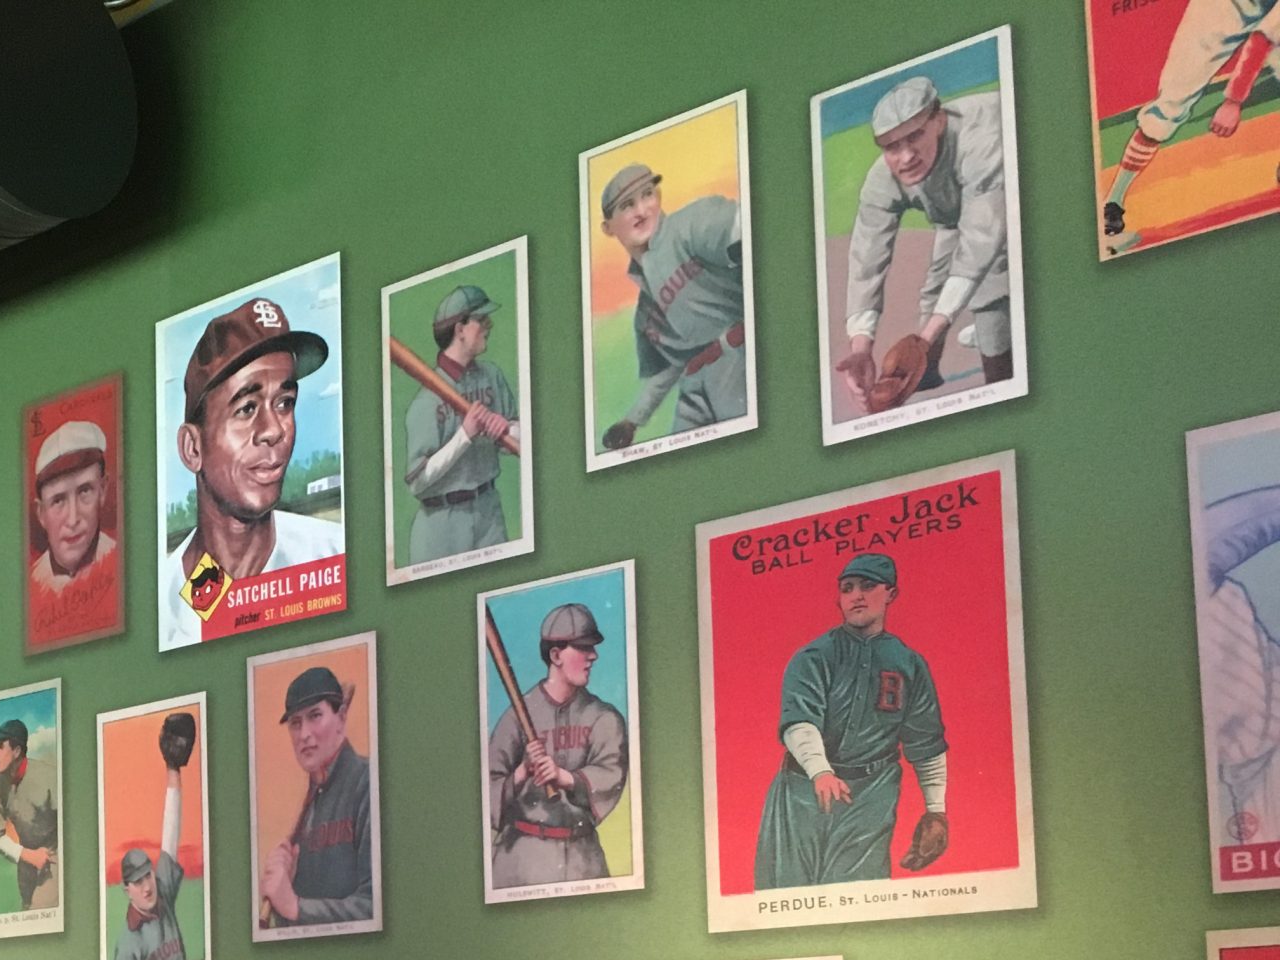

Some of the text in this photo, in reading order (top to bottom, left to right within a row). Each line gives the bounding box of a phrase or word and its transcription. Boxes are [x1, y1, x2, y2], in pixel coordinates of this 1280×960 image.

[732, 482, 979, 561] Cracker Jack
[752, 514, 962, 575] BALL PLAYERS
[227, 565, 342, 608] SATCHELL PAIGE
[234, 594, 342, 628] pitcher ST. LOUIS BROWNS
[758, 896, 833, 914] PERDUE,
[864, 891, 899, 903] LOUIS
[912, 885, 979, 899] NATIONALS
